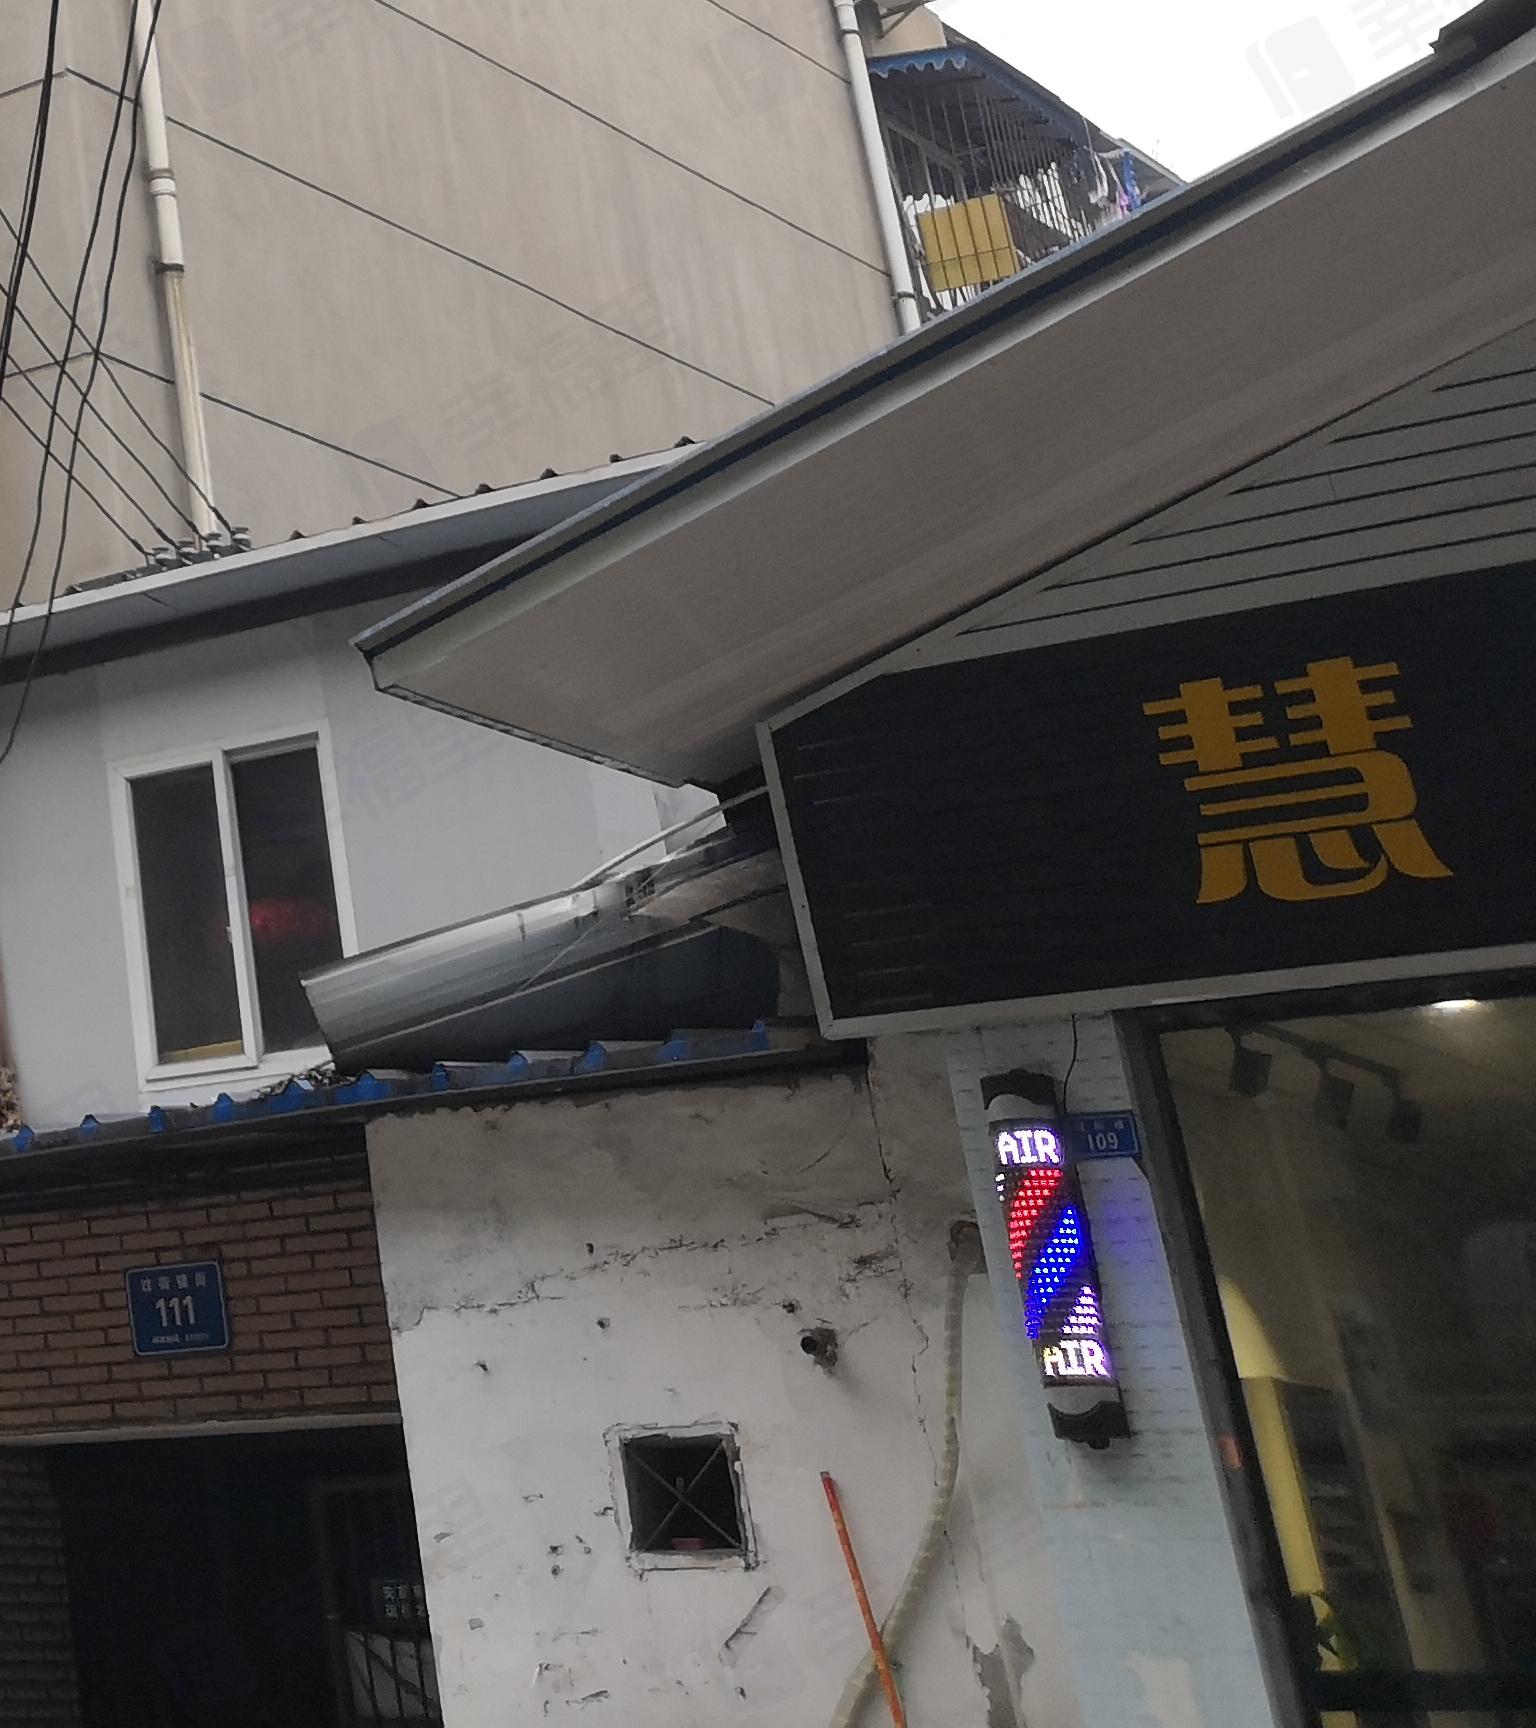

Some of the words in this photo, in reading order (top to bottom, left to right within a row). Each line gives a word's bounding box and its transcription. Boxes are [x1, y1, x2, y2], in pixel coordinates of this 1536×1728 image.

[1141, 656, 1454, 904] 慧
[997, 1129, 1060, 1165] AIR
[1087, 1132, 1119, 1150] 109
[155, 1295, 195, 1327] 111
[1043, 1340, 1108, 1376] AIR
